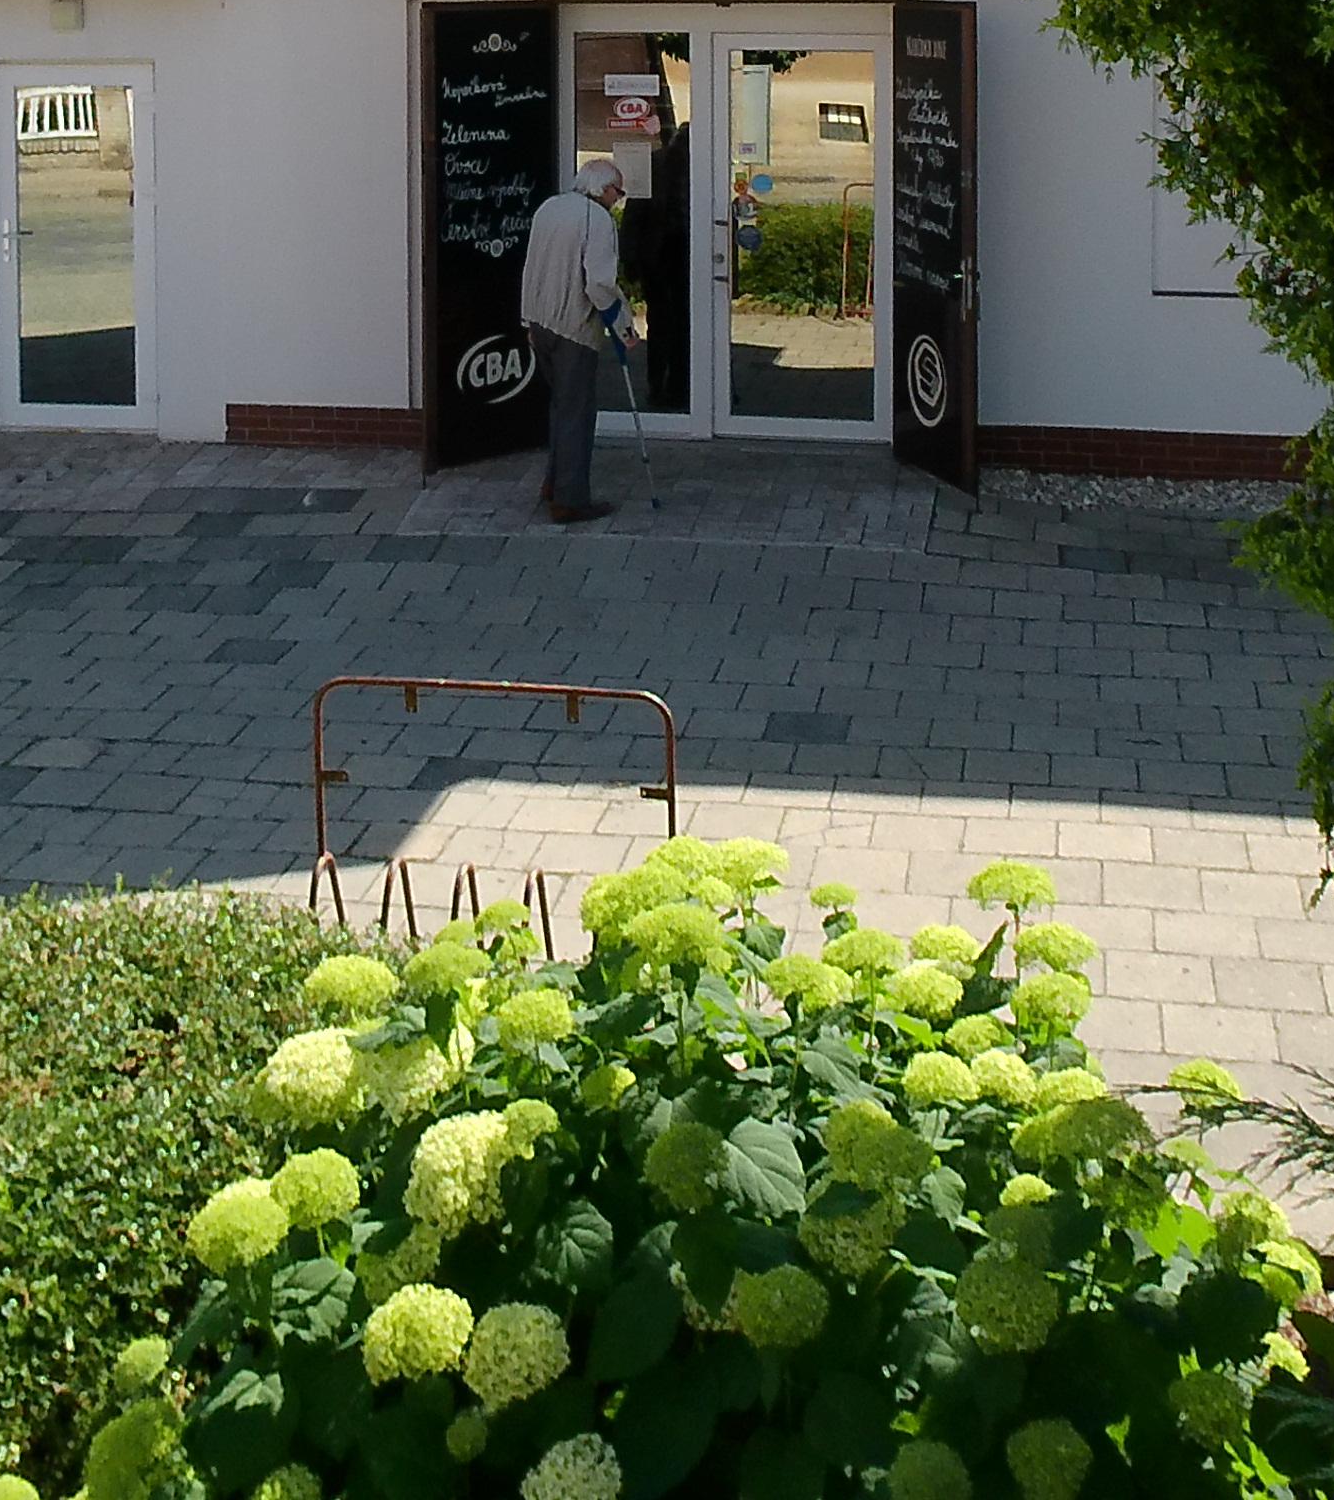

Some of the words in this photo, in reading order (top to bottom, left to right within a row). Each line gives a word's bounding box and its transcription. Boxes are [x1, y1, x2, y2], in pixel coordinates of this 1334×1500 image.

[619, 103, 644, 115] CBA
[441, 120, 510, 145] Zelenina
[468, 348, 523, 388] CBA
